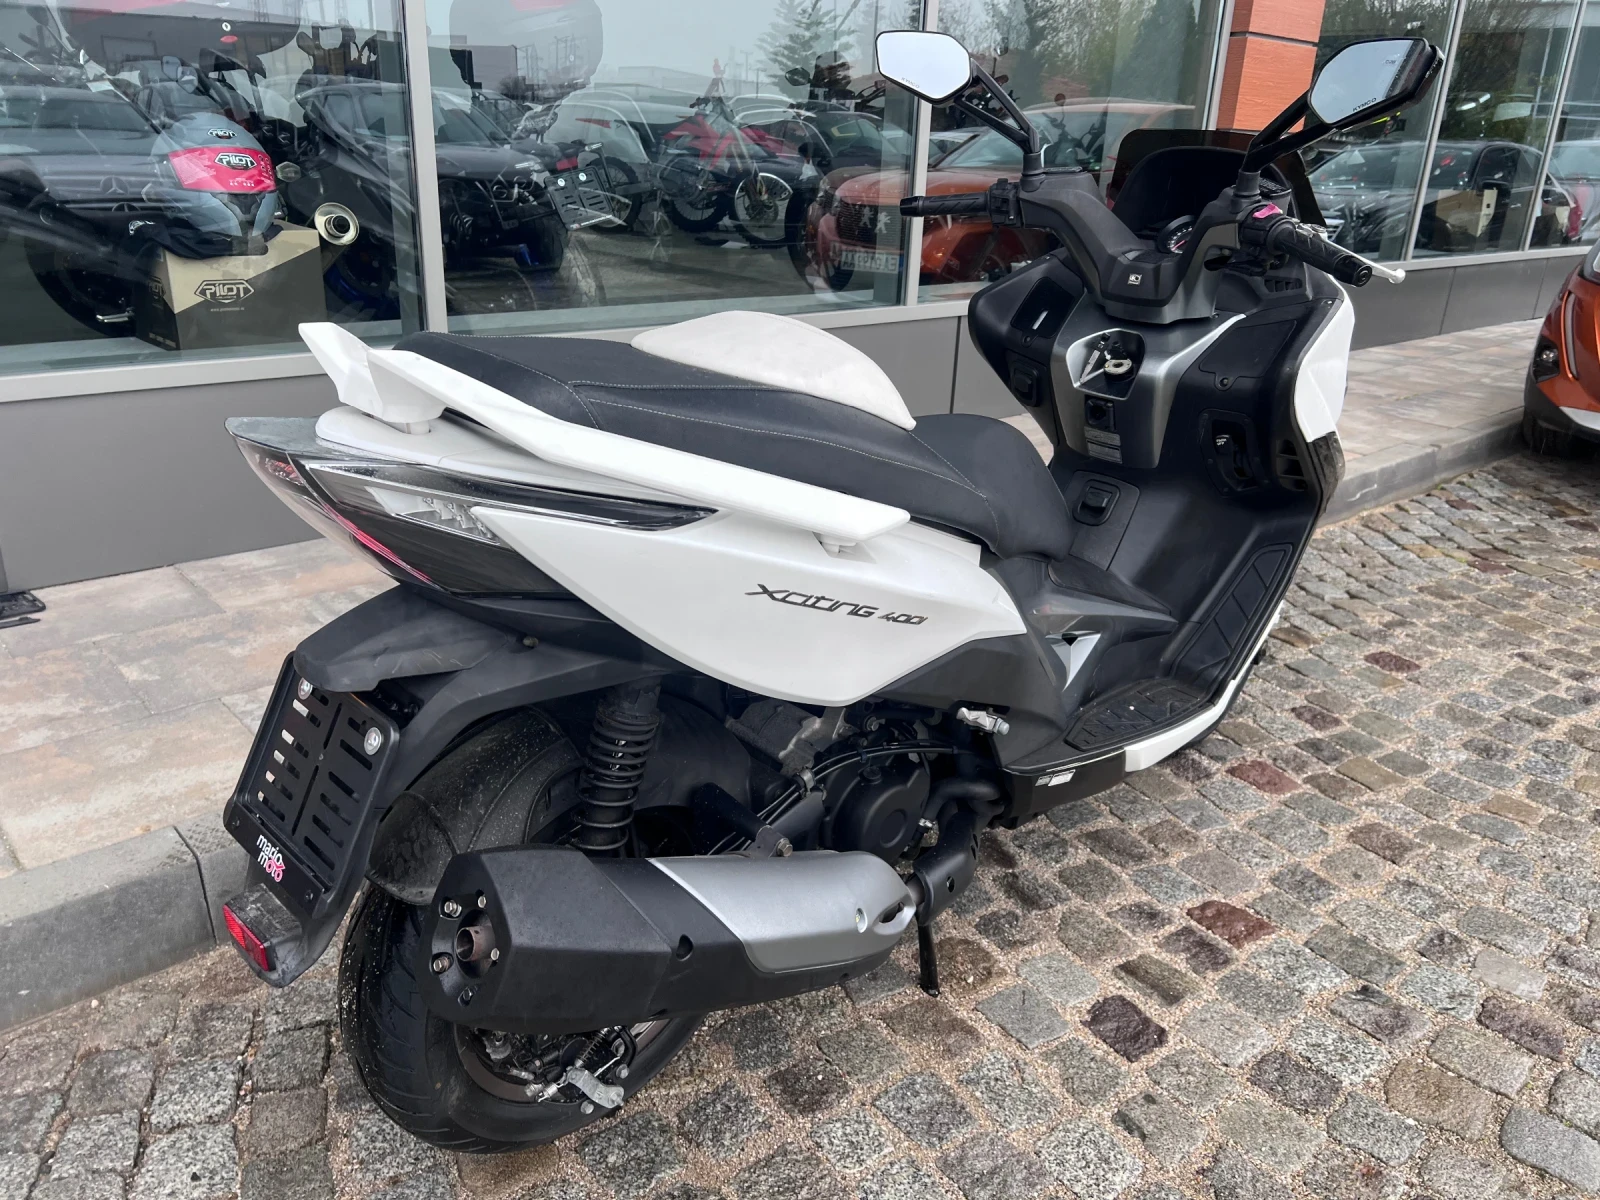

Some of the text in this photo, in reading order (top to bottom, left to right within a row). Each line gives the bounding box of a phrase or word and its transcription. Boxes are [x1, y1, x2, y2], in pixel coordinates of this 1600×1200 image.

[1352, 97, 1377, 112] KYMCO
[256, 834, 283, 865] mario
[257, 851, 284, 882] moto
